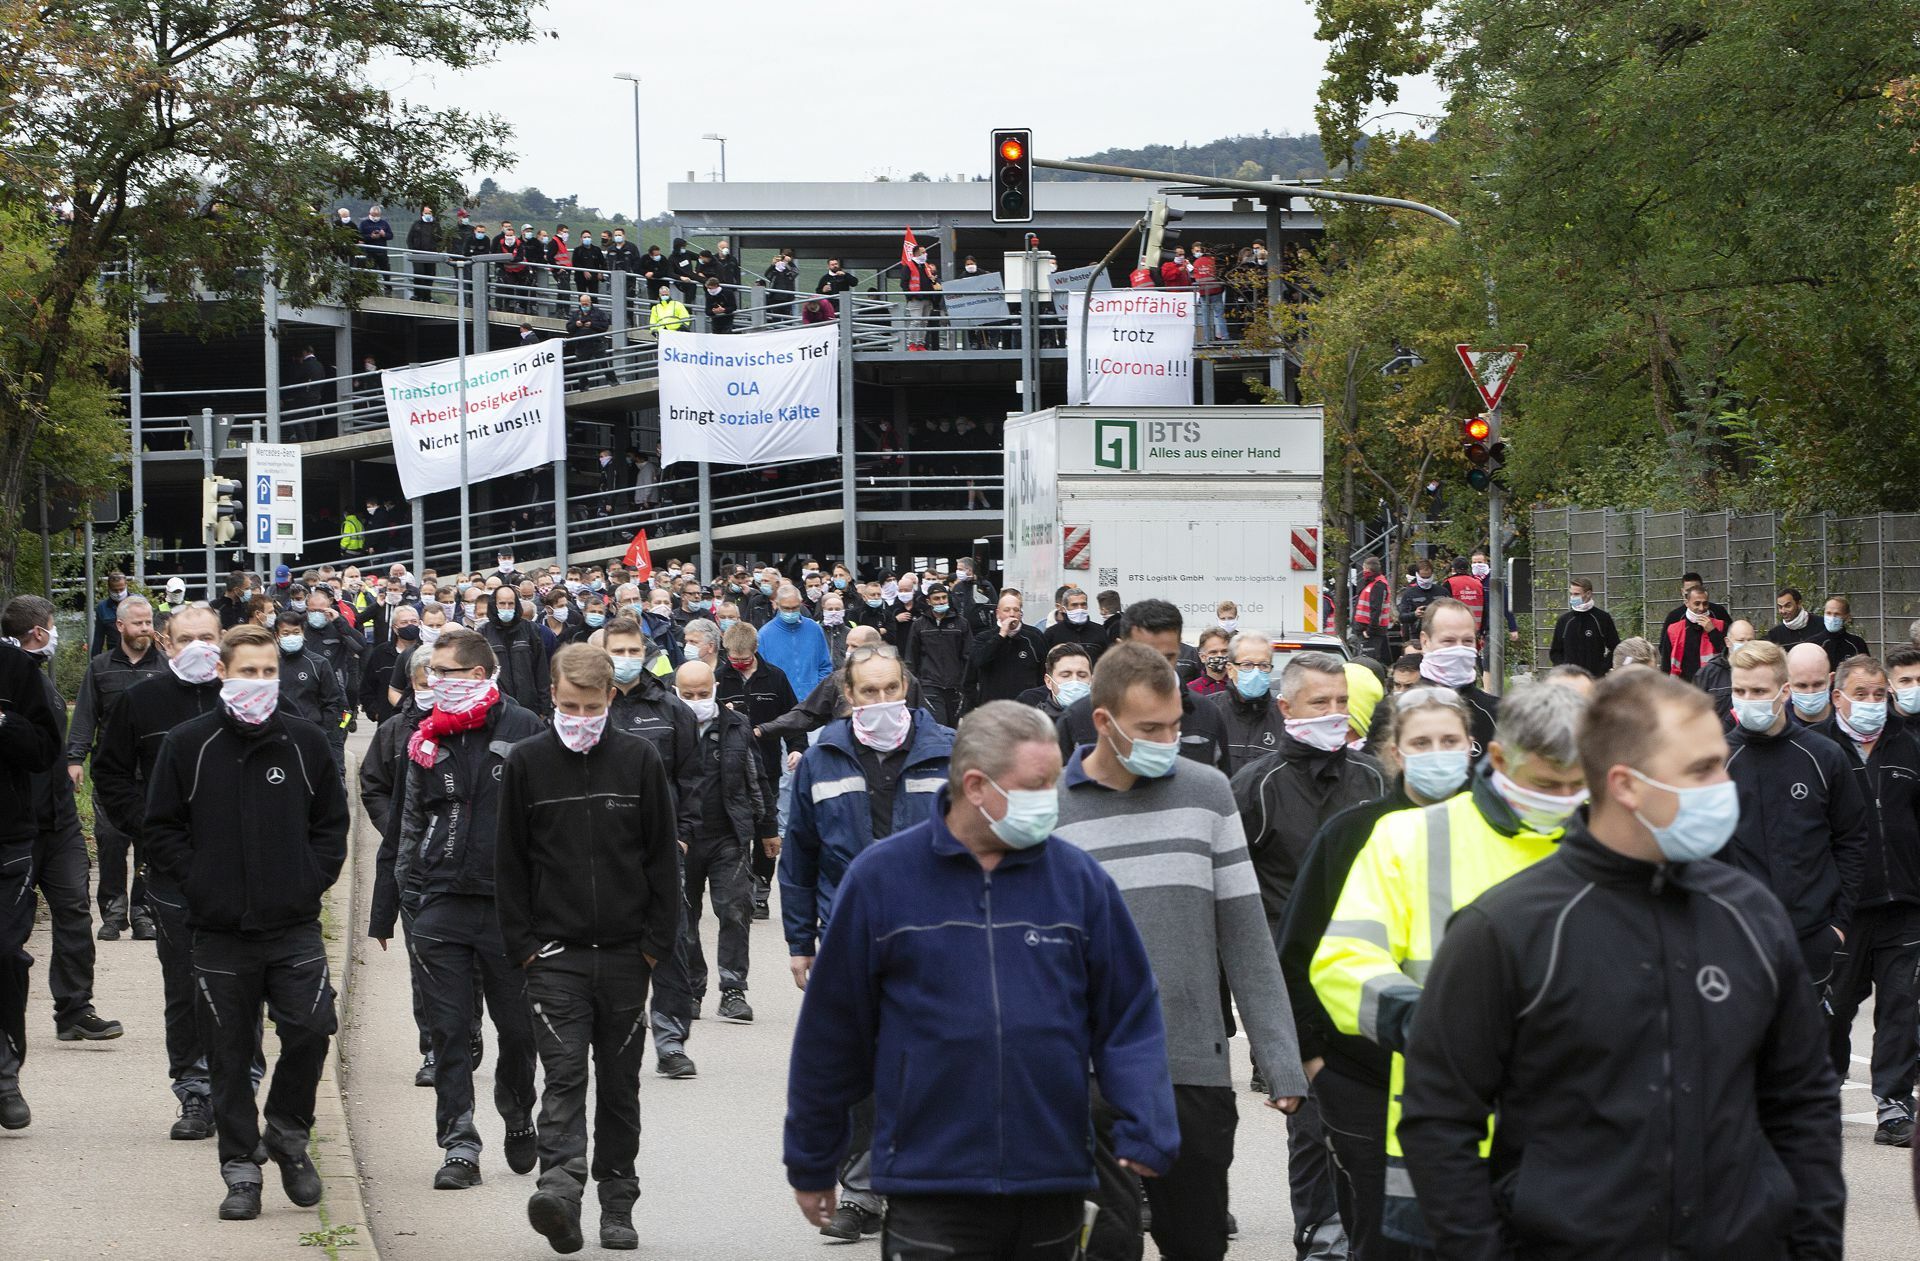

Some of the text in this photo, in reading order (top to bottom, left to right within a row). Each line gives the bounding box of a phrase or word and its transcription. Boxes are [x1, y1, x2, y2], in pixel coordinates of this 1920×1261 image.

[1113, 327, 1154, 344] trotz
[664, 340, 830, 367] Skandinavisches Tief
[389, 352, 556, 401] Transformation in die
[727, 381, 760, 396] OLA
[670, 404, 821, 426] bringt soziale Kälte
[419, 408, 542, 452] Nicht mit uns!!!
[1148, 421, 1201, 443] BTS
[1148, 447, 1281, 459] Alles aus einer Hand
[260, 518, 269, 540] P
[1128, 574, 1145, 582] BTS
[1146, 574, 1178, 583] Logistik
[1180, 574, 1204, 582] GmbH
[443, 772, 461, 859] Mercedesenz
